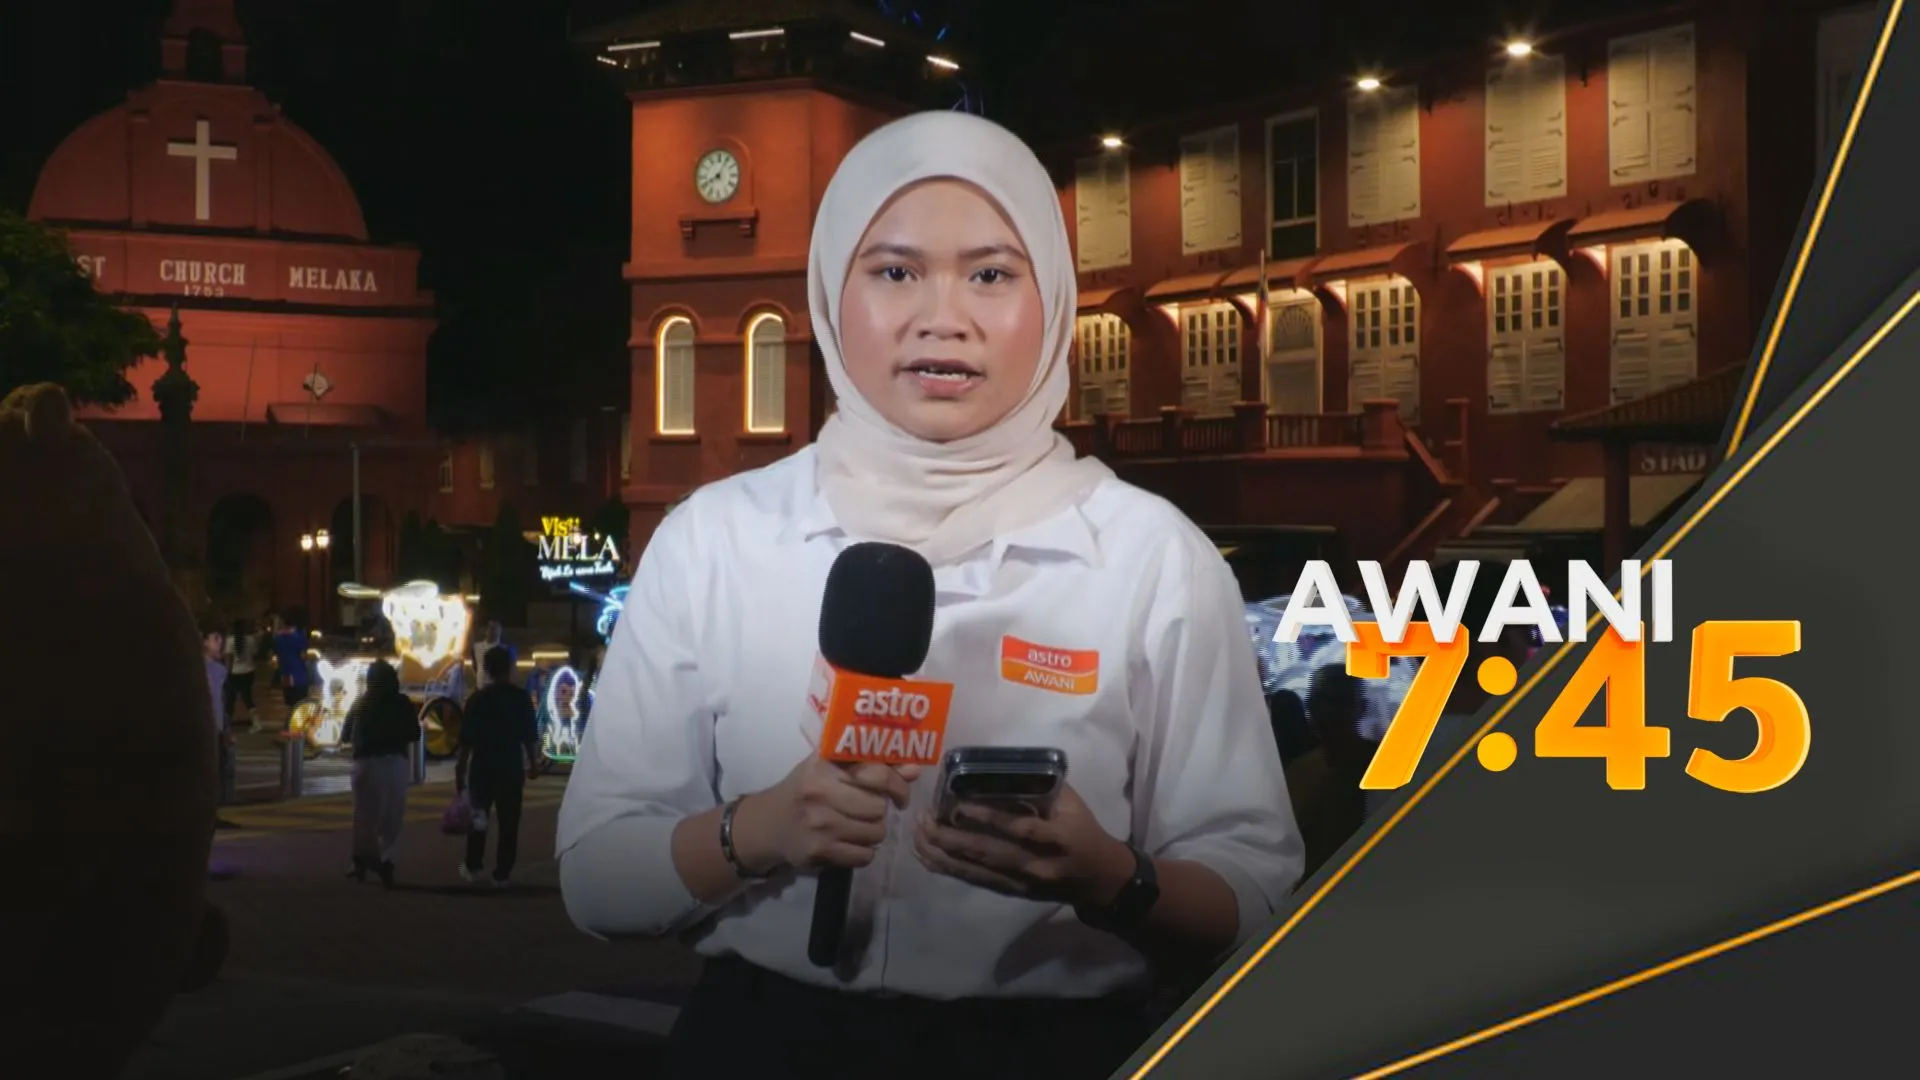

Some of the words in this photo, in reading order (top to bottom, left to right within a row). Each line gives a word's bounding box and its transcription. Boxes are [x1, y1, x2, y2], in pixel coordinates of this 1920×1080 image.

[75, 253, 107, 278] ST
[160, 259, 246, 285] CHURCH
[289, 266, 378, 292] MELAKA
[1027, 646, 1073, 668] astro
[1023, 669, 1076, 690] AWANI
[854, 686, 930, 720] astro
[835, 724, 938, 759] AWANI
